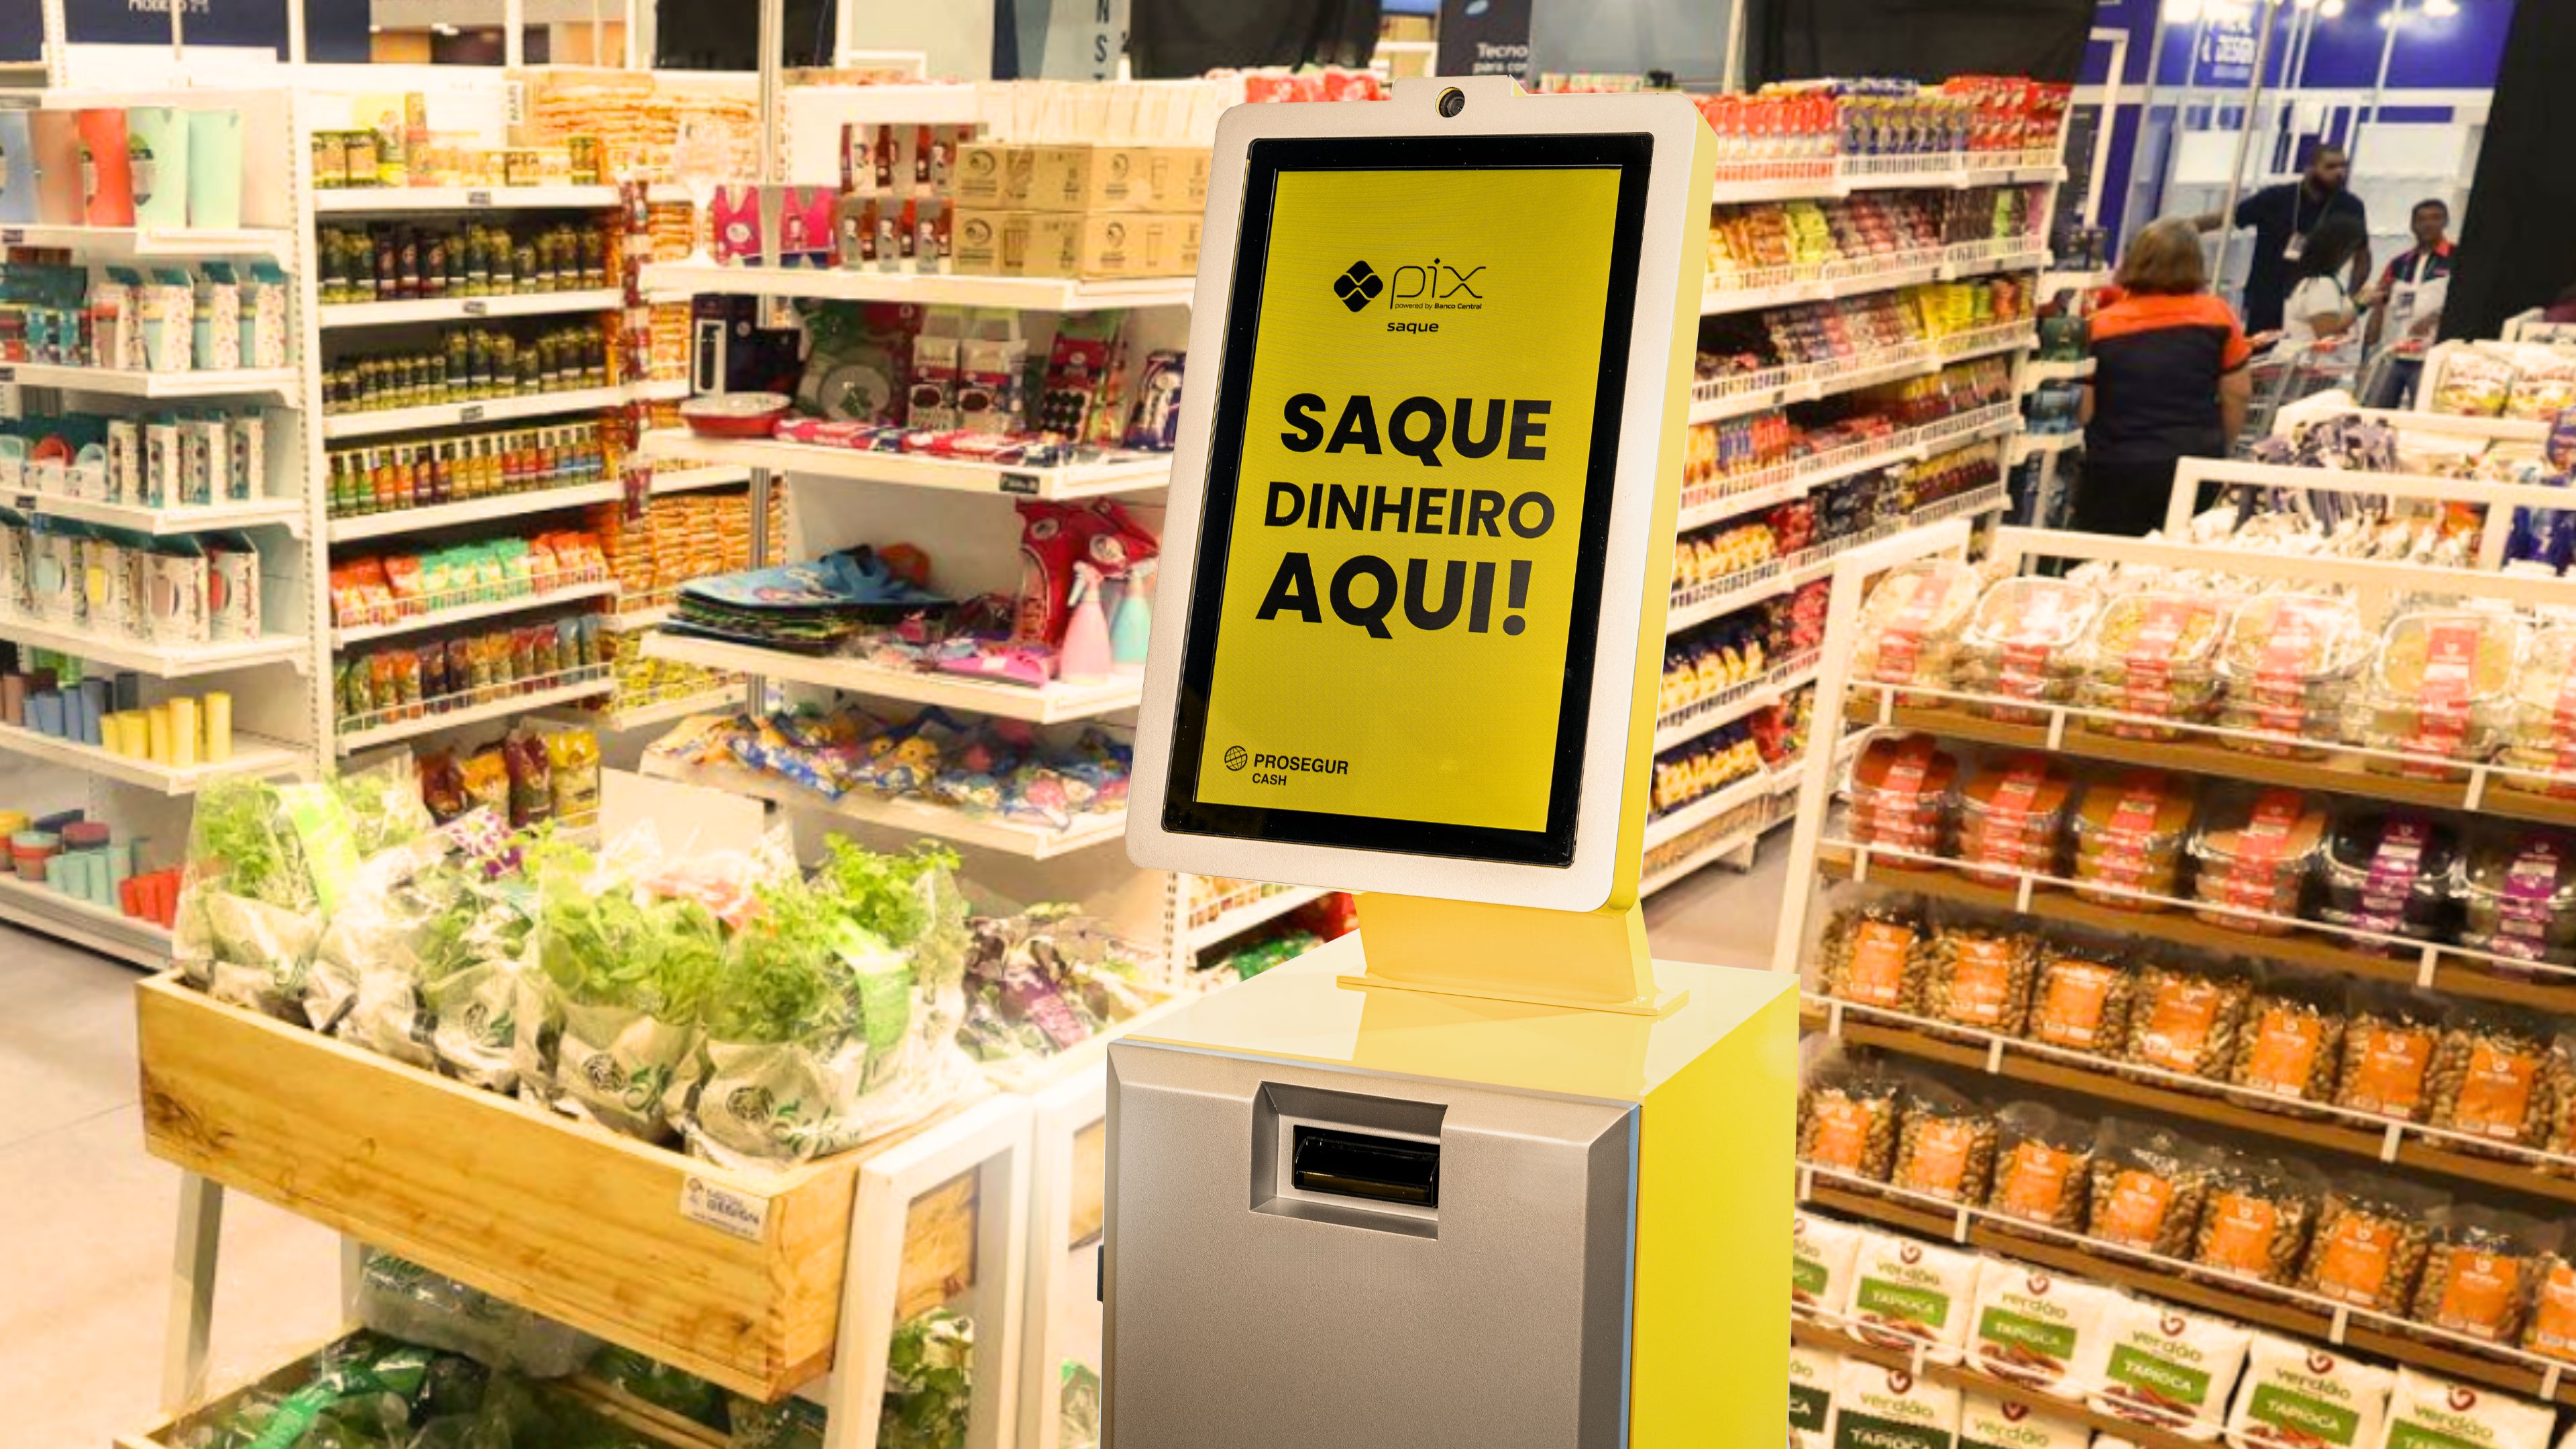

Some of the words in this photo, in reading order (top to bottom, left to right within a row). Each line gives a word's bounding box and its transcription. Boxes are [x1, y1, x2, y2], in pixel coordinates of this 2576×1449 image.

[1390, 258, 1487, 310] pix
[1395, 303, 1424, 311] powered
[1424, 303, 1434, 311] by
[1457, 303, 1483, 311] Central
[1387, 322, 1440, 335] saque
[1281, 392, 1552, 468] SAQUE
[1264, 481, 1556, 539] DINHEIRO
[1255, 551, 1534, 640] AQUI!
[1252, 772, 1288, 786] CASH
[1254, 753, 1349, 775] PROSEGUR
[2275, 1366, 2352, 1401] verdão
